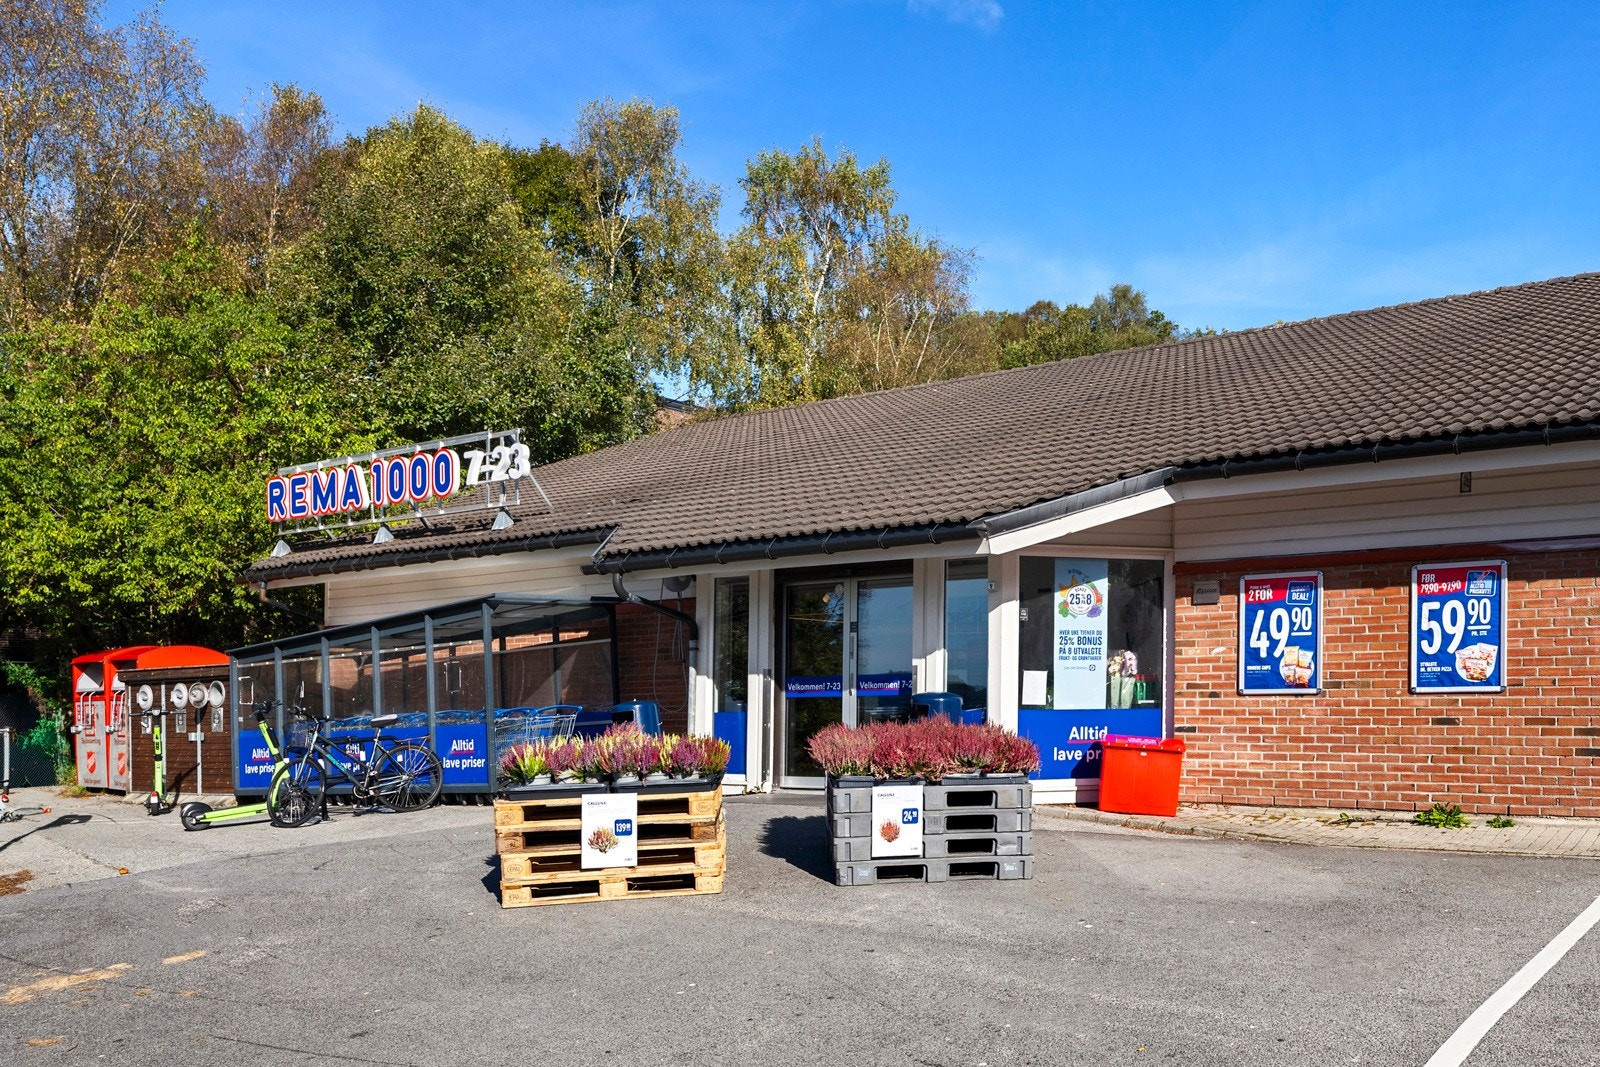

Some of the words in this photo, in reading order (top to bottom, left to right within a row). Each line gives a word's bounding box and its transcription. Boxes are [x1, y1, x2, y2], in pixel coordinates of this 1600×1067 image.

[266, 463, 367, 522] REMA
[370, 448, 458, 507] 1000
[463, 443, 531, 485] 7-23
[1421, 573, 1436, 583] FØR
[1069, 593, 1081, 605] 25
[1086, 593, 1092, 605] 8
[1248, 590, 1254, 601] 2
[1255, 589, 1273, 601] FOR
[1059, 635, 1075, 646] 25%
[1077, 636, 1103, 646] BONUS
[1068, 647, 1072, 655] 8
[1073, 647, 1102, 655] UTVALGTE
[787, 682, 825, 691] Velkommen!
[826, 682, 841, 690] 7-23
[860, 680, 900, 689] Velkommen!
[901, 680, 912, 689] 7-2
[1068, 726, 1108, 740] Alltid
[451, 739, 474, 751] Alltid
[251, 748, 270, 759] Alltid
[1053, 747, 1083, 761] lave
[244, 763, 259, 774] lave
[259, 762, 275, 775] prise
[442, 756, 460, 769] lave
[461, 755, 486, 770] priser
